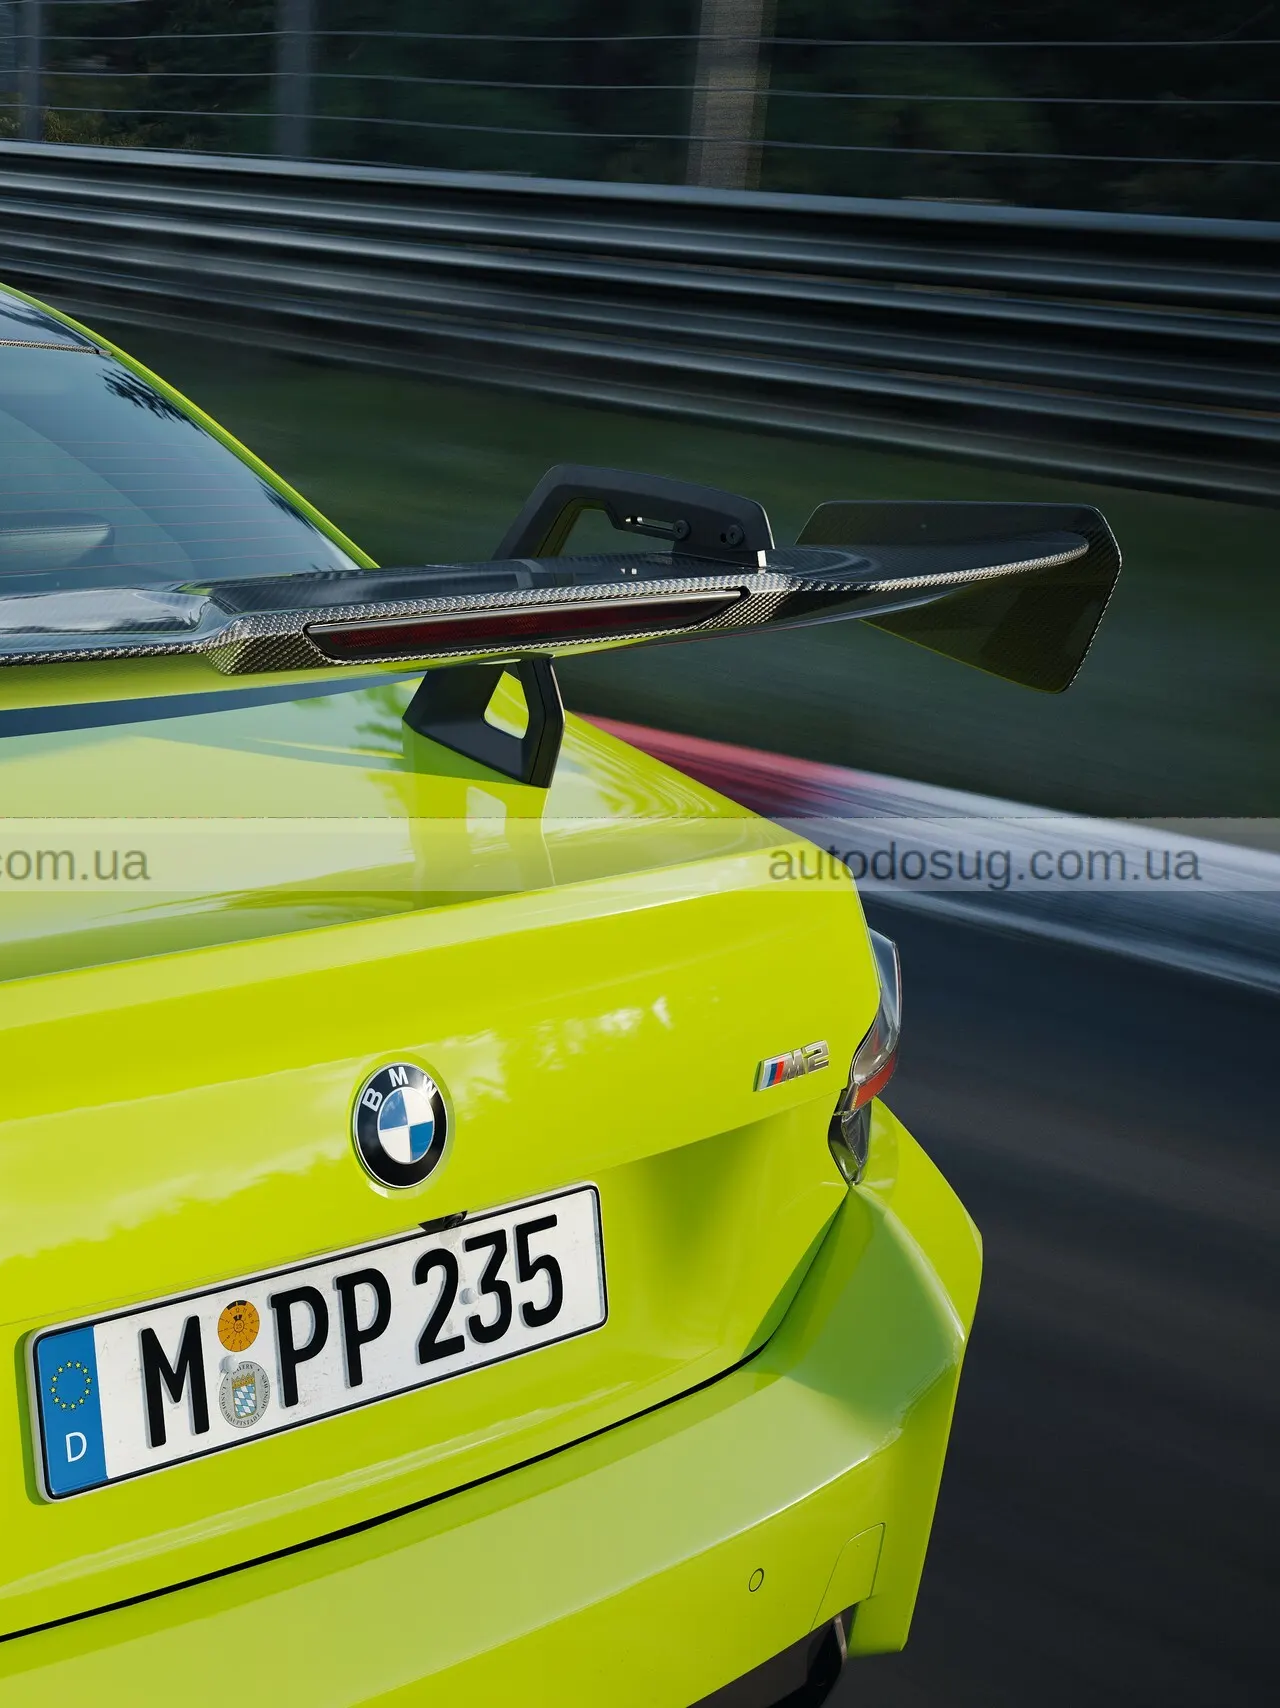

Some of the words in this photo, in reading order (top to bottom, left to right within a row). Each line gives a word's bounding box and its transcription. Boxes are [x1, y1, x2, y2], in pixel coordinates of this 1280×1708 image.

[779, 1039, 830, 1082] M2
[362, 1066, 438, 1112] BMW
[140, 1314, 210, 1449] M
[269, 1267, 392, 1409] PP
[413, 1214, 565, 1366] 235
[65, 1431, 88, 1463] D
